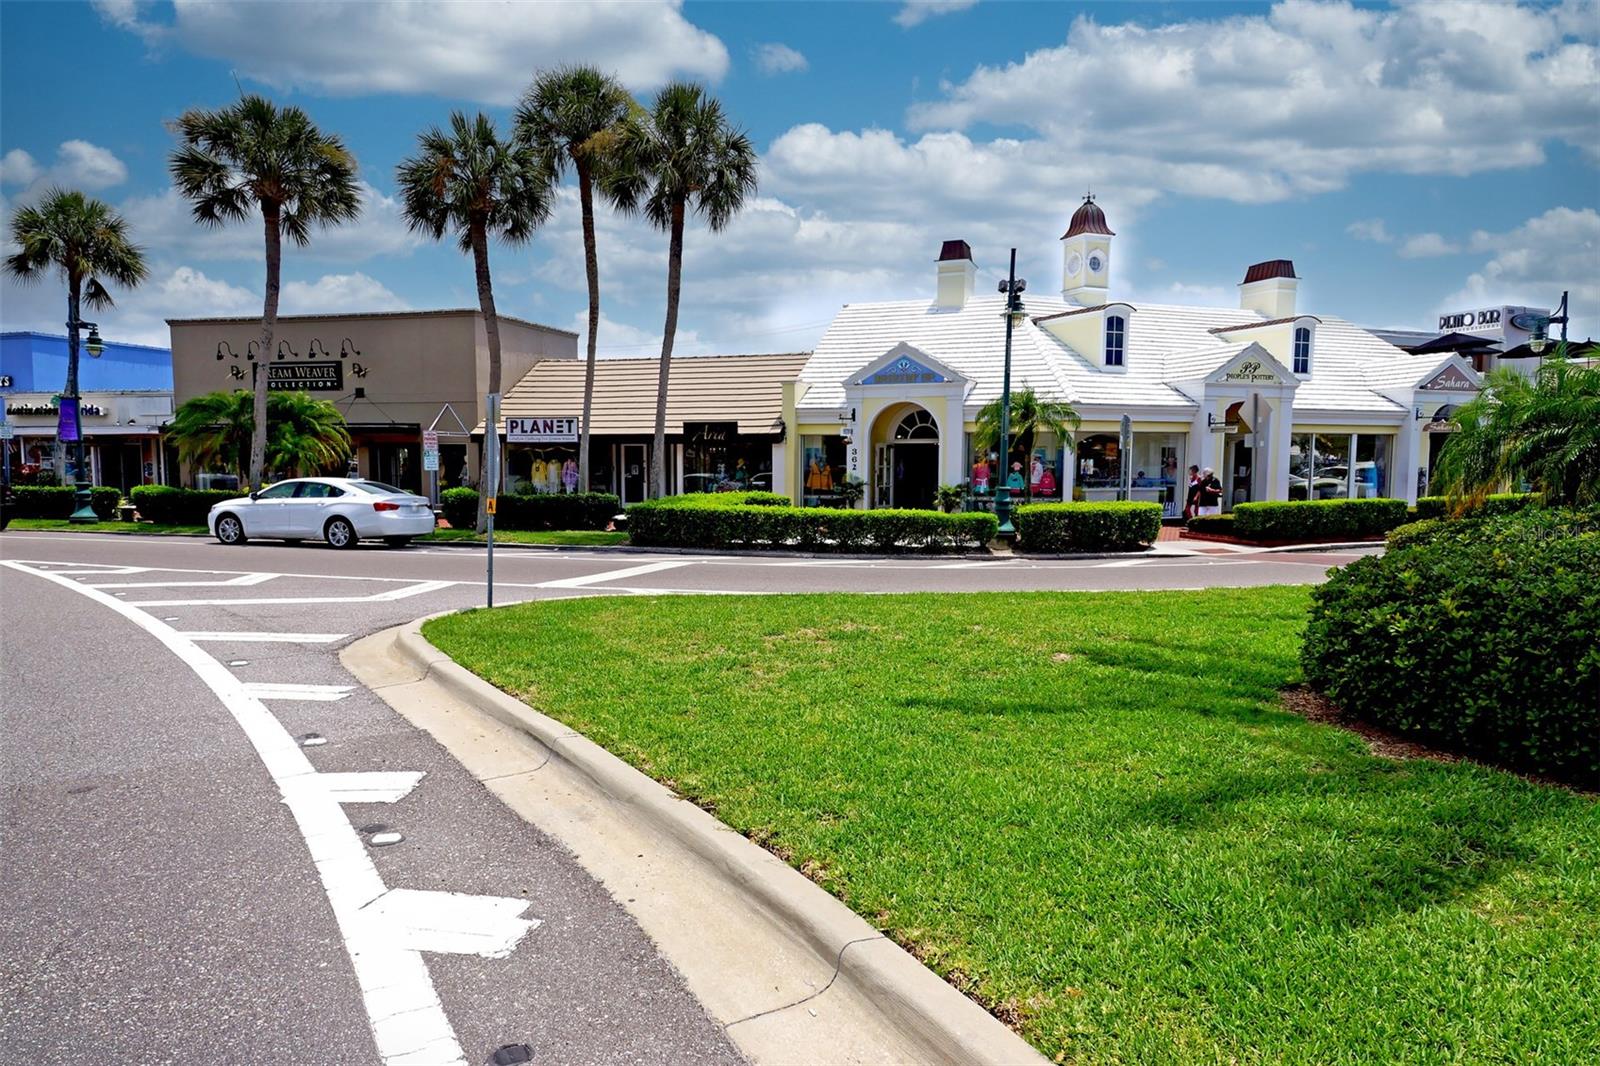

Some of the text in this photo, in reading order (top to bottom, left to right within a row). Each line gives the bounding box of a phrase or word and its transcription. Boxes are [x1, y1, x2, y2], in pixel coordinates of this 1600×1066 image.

[1478, 310, 1501, 325] BAR
[266, 366, 336, 378] REAM WEAVER
[1434, 375, 1470, 389] Sahara
[510, 419, 574, 434] PLANET
